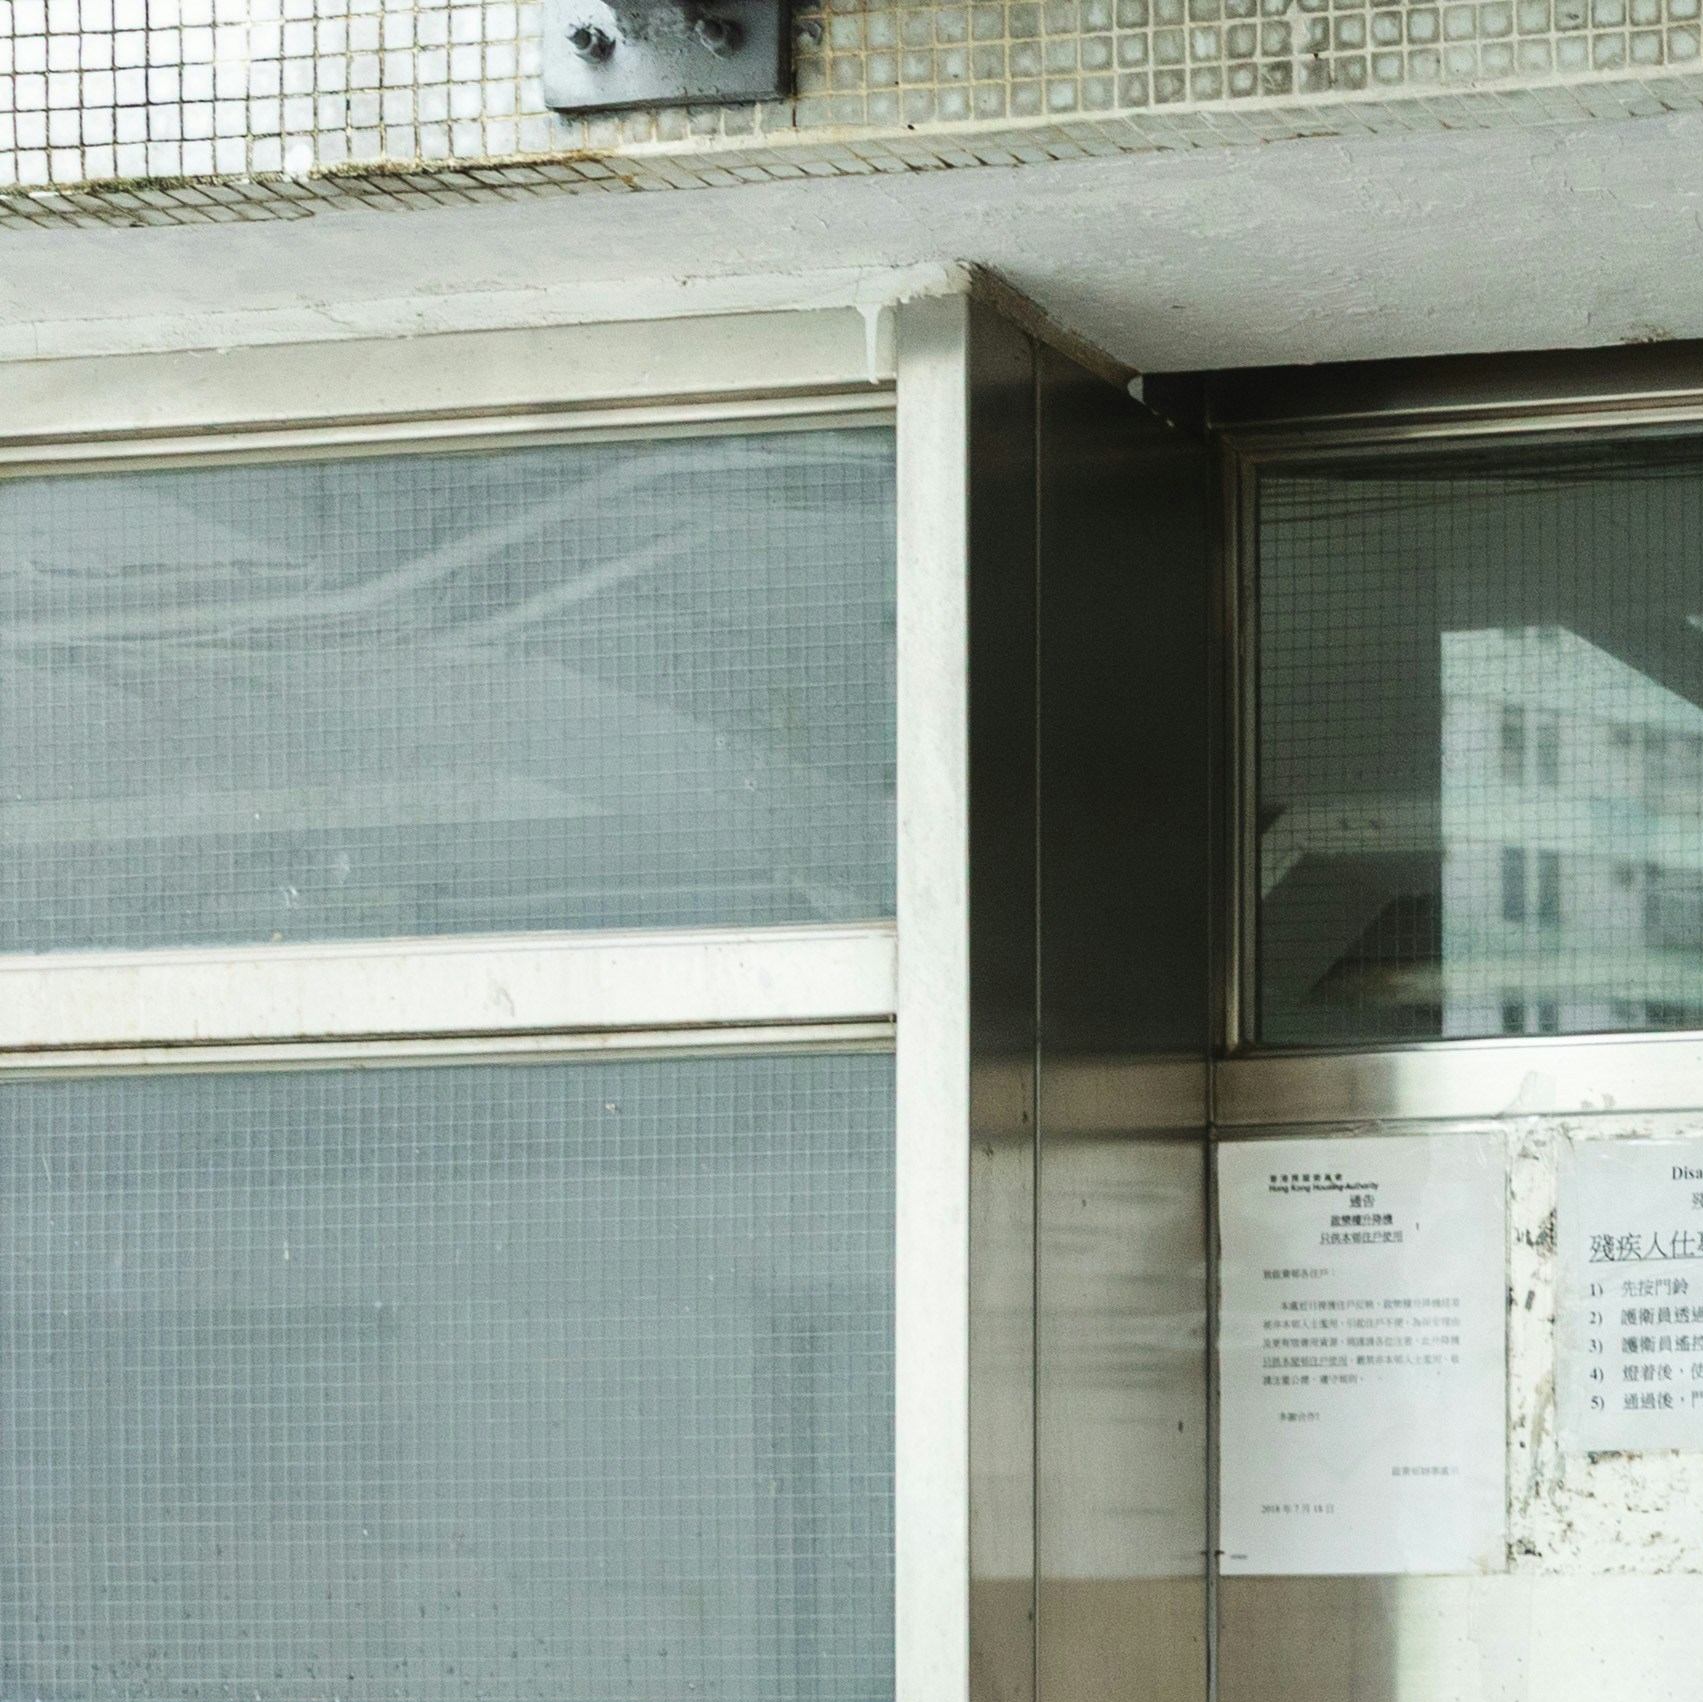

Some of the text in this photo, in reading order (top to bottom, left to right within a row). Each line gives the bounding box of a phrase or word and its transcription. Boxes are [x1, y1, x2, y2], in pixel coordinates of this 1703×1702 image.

[1349, 1194, 1375, 1208] 通告
[1589, 1278, 1688, 1298] 1) 先按門鈴
[1589, 1310, 1603, 1325] 2)
[1588, 1338, 1603, 1355] 3)
[1589, 1367, 1604, 1382] 4)
[1590, 1396, 1605, 1411] 5)
